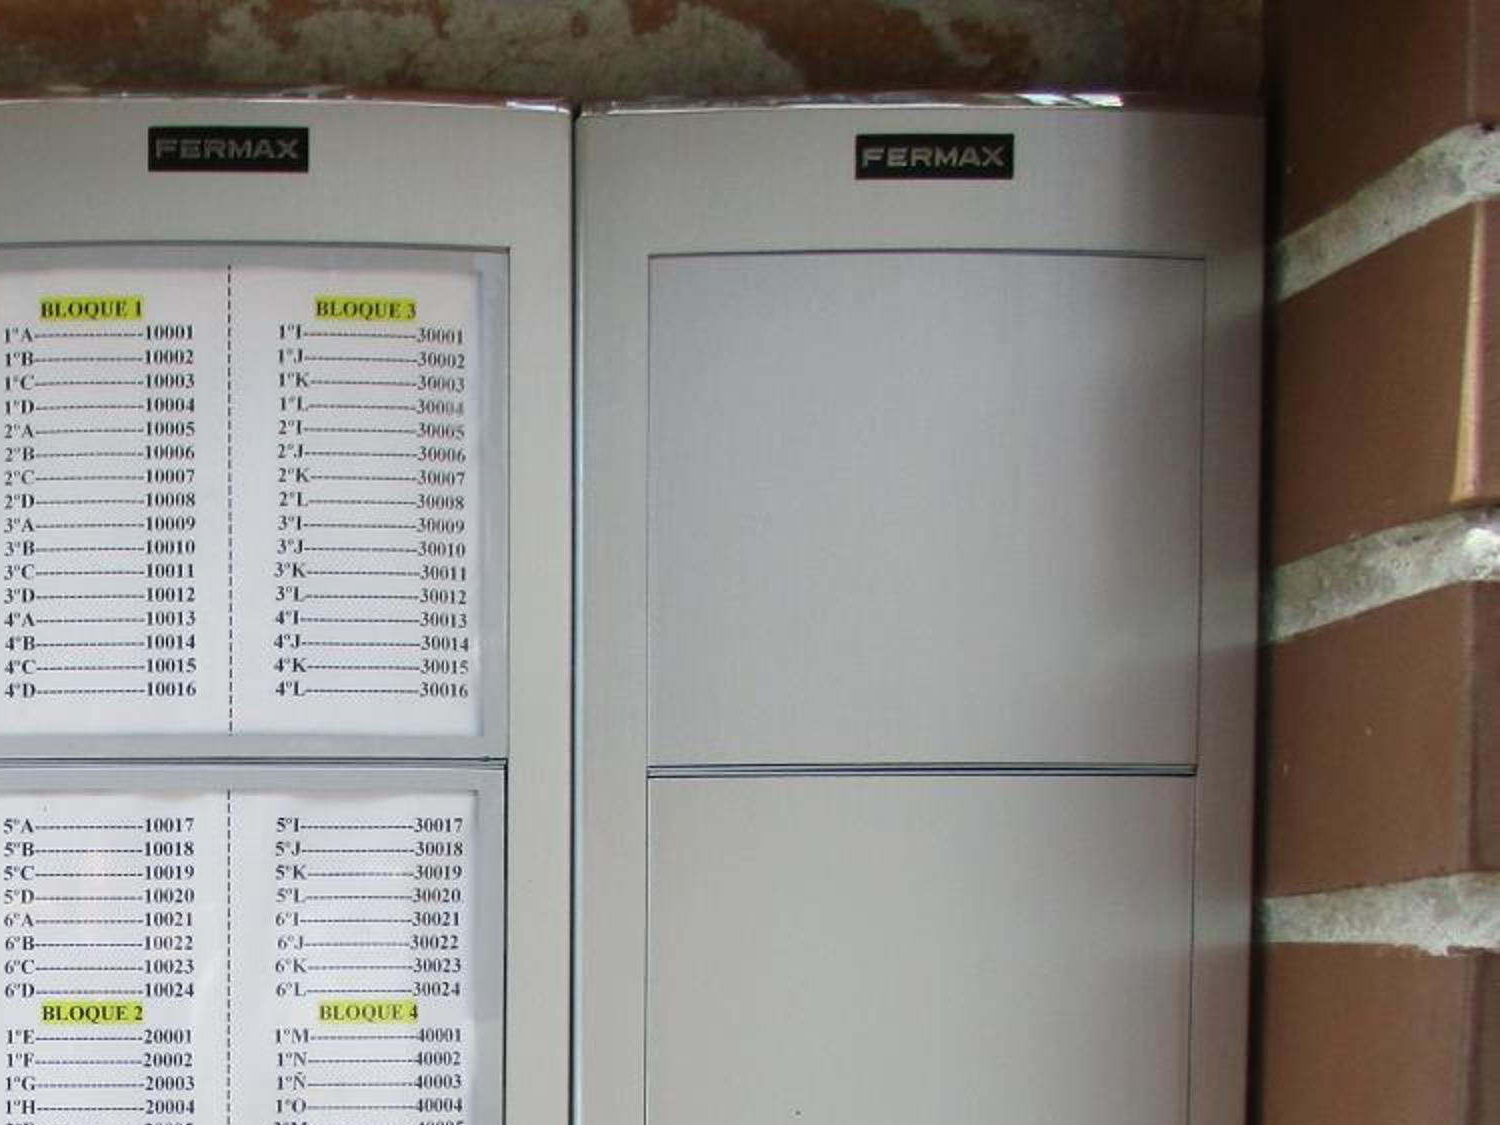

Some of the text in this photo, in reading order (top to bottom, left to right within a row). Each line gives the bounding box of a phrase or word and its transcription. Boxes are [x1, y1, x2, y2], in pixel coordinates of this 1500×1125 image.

[154, 139, 299, 160] FERMAX
[862, 147, 1005, 167] FERMAX
[41, 301, 142, 318] BLOQUE 1
[315, 301, 417, 319] BLOQUE 3
[142, 324, 194, 341] 10001
[412, 328, 464, 345] 30001
[143, 348, 195, 365] 10002
[414, 352, 466, 369] 30002
[144, 372, 196, 389] 10003
[144, 396, 196, 413] 10004
[144, 420, 196, 437] 10005
[144, 444, 196, 461] 10006
[415, 446, 467, 463] 30006
[144, 467, 196, 484] 10007
[414, 470, 466, 487] 30007
[145, 491, 197, 508] 10008
[145, 515, 197, 532] 10009
[414, 517, 466, 534] 30009
[144, 539, 196, 556] 10010
[415, 541, 467, 558] 30010
[142, 562, 194, 579] 10011
[415, 565, 467, 582] 30011
[144, 586, 196, 603] 10012
[415, 588, 467, 605] 30012
[145, 610, 197, 627] 10013
[416, 612, 468, 629] 30013
[144, 634, 196, 651] 10014
[414, 635, 466, 652] 30014
[145, 657, 197, 674] 10015
[417, 658, 469, 675] 30015
[145, 680, 197, 697] 10016
[417, 681, 469, 698] 30016
[143, 817, 195, 834] 10017
[411, 817, 463, 834] 30017
[144, 840, 196, 857] 10018
[411, 840, 463, 857] 30018
[144, 864, 196, 881] 10019
[411, 864, 463, 881] 30019
[144, 887, 196, 904] 10020
[410, 887, 462, 904] 30020
[142, 911, 194, 928] 10021
[408, 910, 460, 927] 30021
[143, 934, 195, 951] 10022
[408, 934, 460, 951] 30022
[143, 958, 195, 975] 10023
[410, 957, 462, 974] 30023
[144, 981, 196, 998] 10024
[409, 980, 461, 997] 30024
[42, 1005, 143, 1023] BLOQUE 2
[319, 1004, 419, 1021] BLOQUE 4
[140, 1028, 192, 1045] 20001
[410, 1027, 462, 1044] 40001
[142, 1051, 194, 1068] 20002
[410, 1050, 462, 1067] 40002
[144, 1075, 196, 1092] 20003
[411, 1073, 463, 1090] 40003
[144, 1098, 196, 1115] 20004
[411, 1096, 463, 1113] 40004
